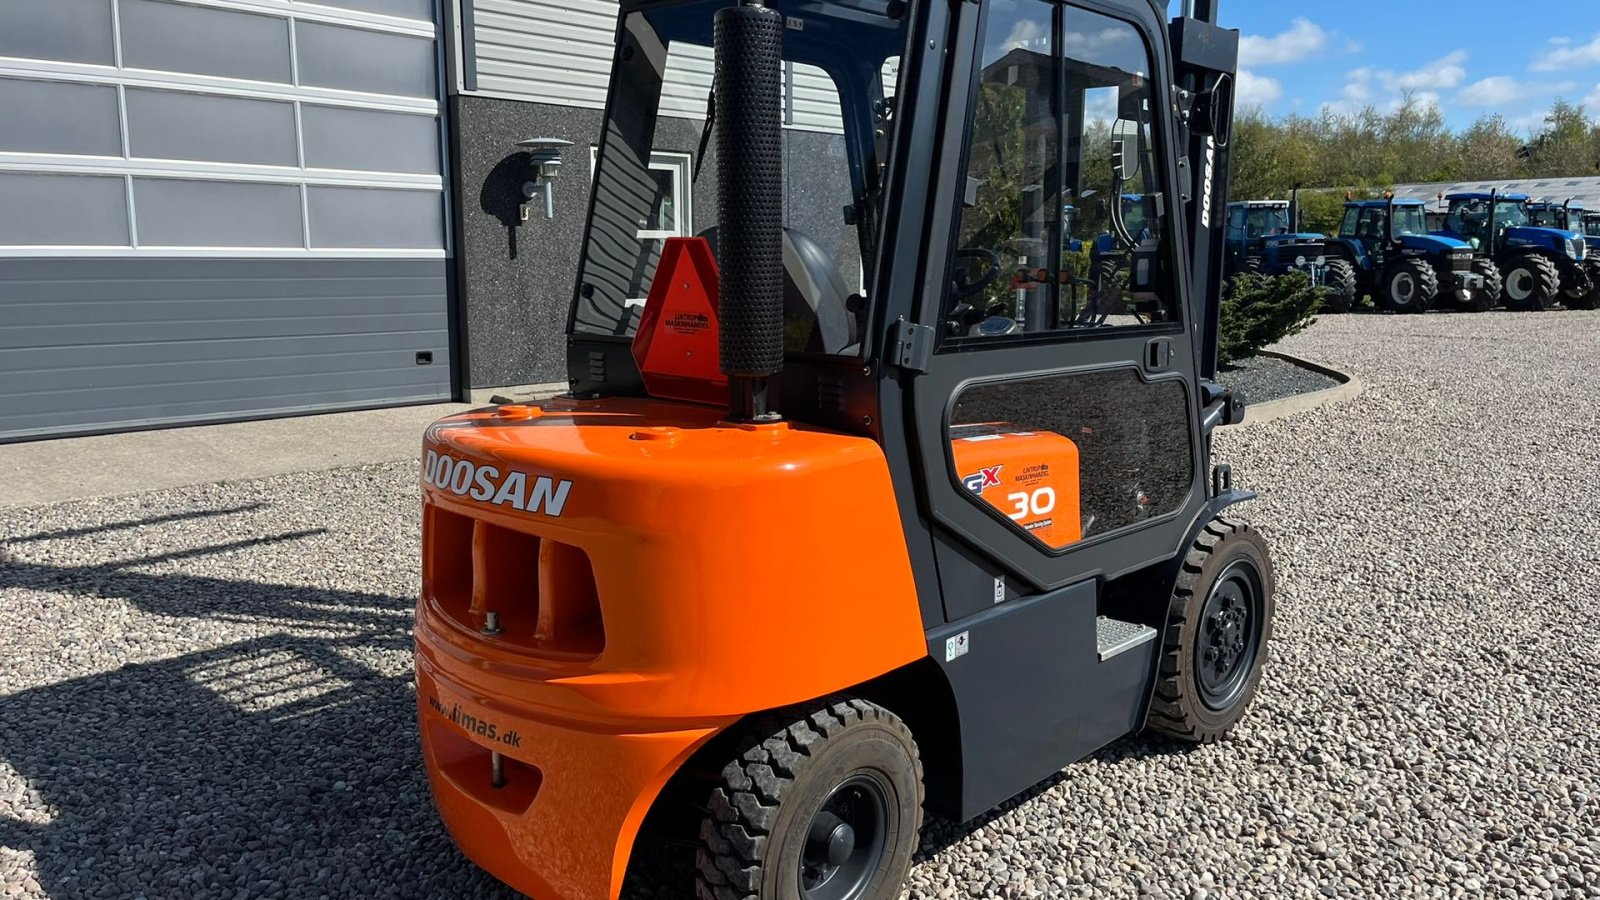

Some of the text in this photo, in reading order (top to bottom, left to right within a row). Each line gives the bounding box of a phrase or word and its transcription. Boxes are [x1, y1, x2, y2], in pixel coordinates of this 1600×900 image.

[423, 450, 573, 517] DOOSAN
[962, 464, 1003, 495] GX
[1007, 486, 1056, 520] 30
[429, 695, 522, 747] www.limas.dk
